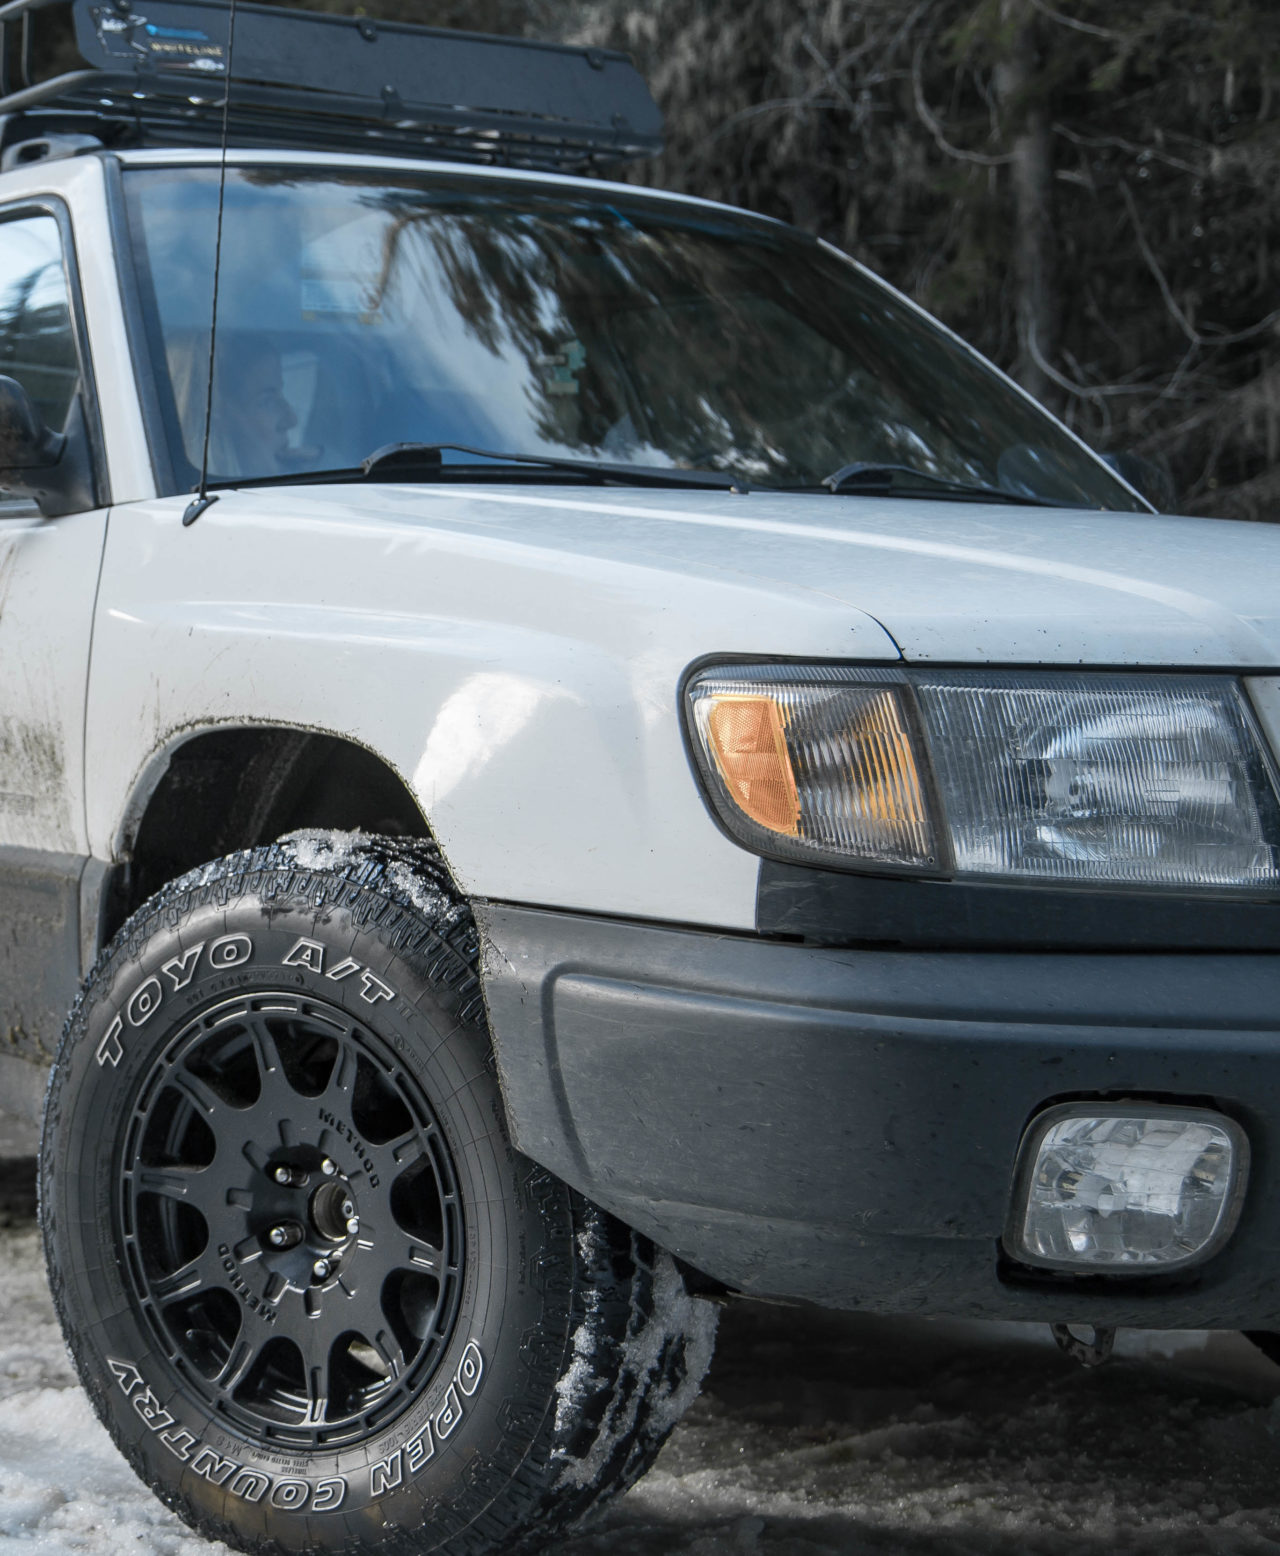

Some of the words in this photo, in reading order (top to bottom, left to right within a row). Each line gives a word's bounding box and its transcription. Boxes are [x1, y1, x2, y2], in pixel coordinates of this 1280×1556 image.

[96, 932, 253, 1068] TOYO
[281, 936, 396, 1005] A/T
[318, 1107, 381, 1190] METHOD
[217, 1243, 278, 1327] METHOD
[106, 1357, 346, 1512] COUNTRY
[370, 1339, 484, 1497] OPEN
